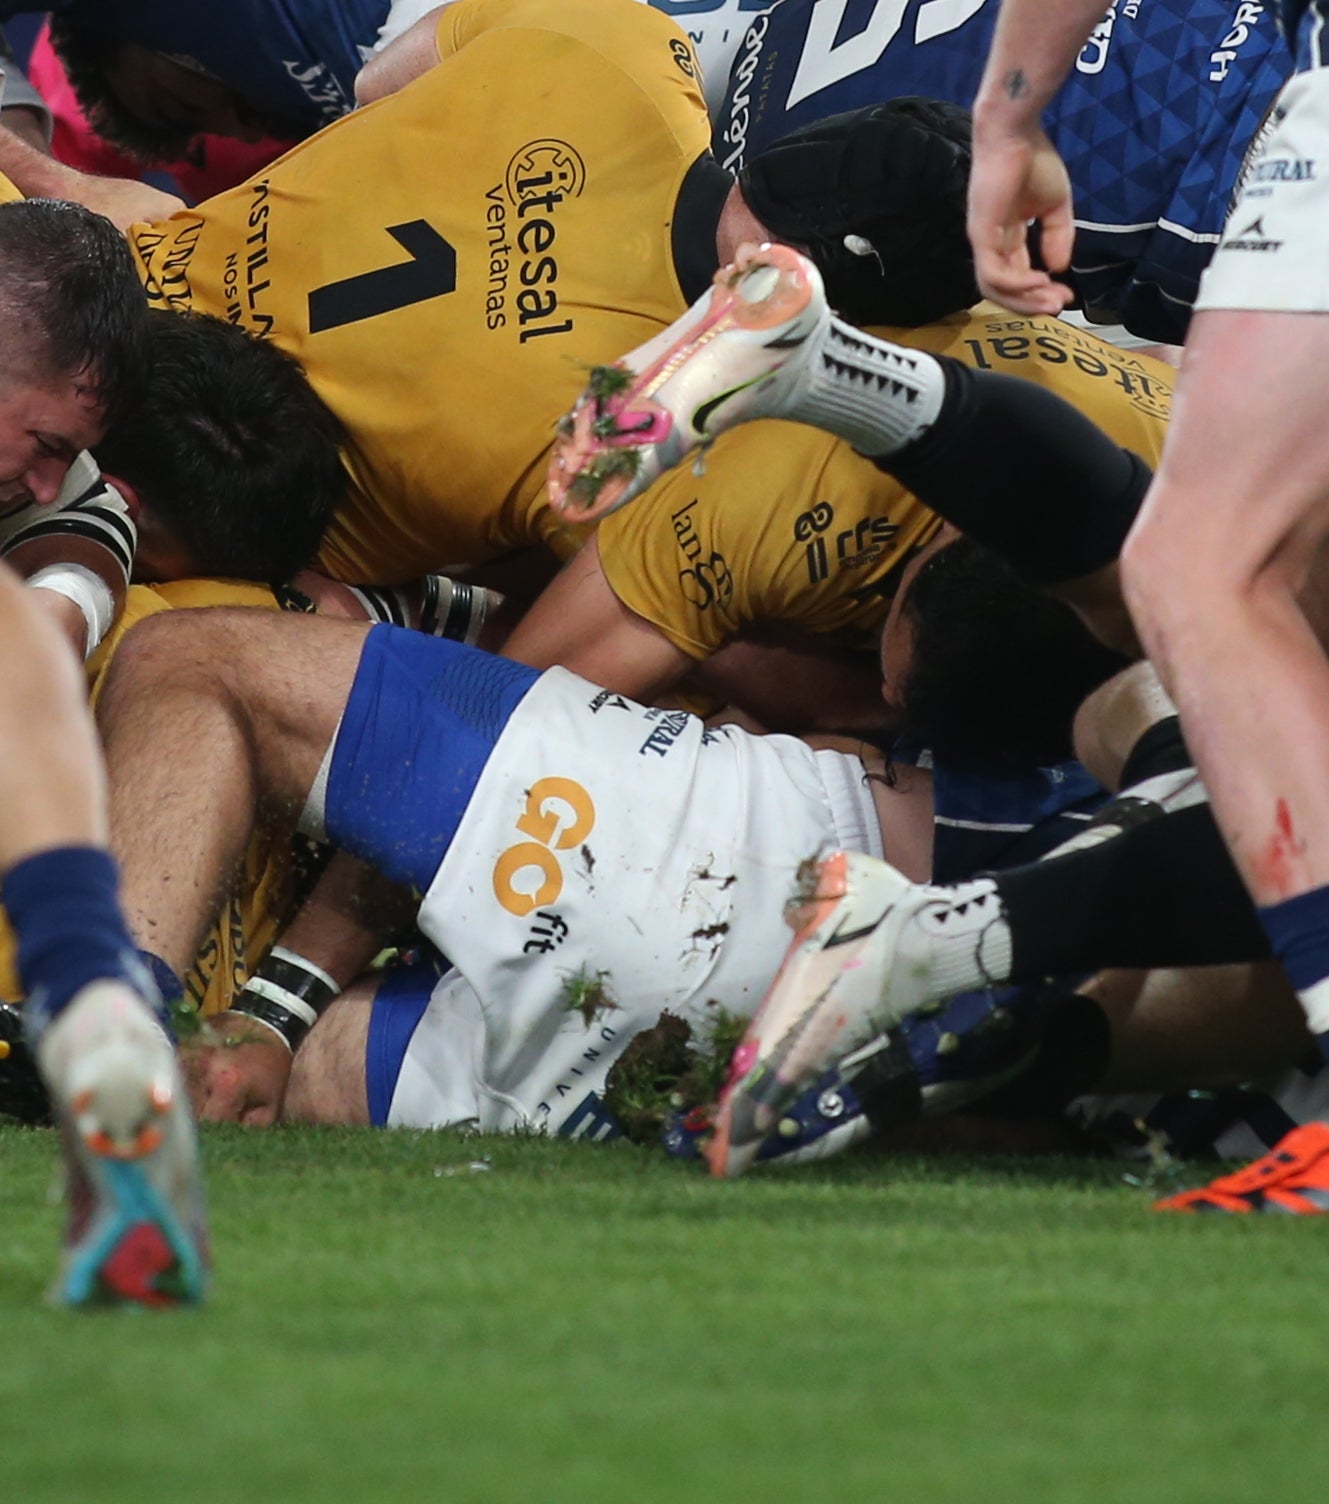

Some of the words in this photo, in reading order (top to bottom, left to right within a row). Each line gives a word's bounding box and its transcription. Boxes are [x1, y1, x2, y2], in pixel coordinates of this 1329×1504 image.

[307, 218, 457, 335] 1
[484, 183, 514, 331] ventanas
[514, 171, 573, 344] itesal
[965, 334, 1157, 405] itesal
[492, 776, 595, 918] GO
[522, 910, 569, 955] fit
